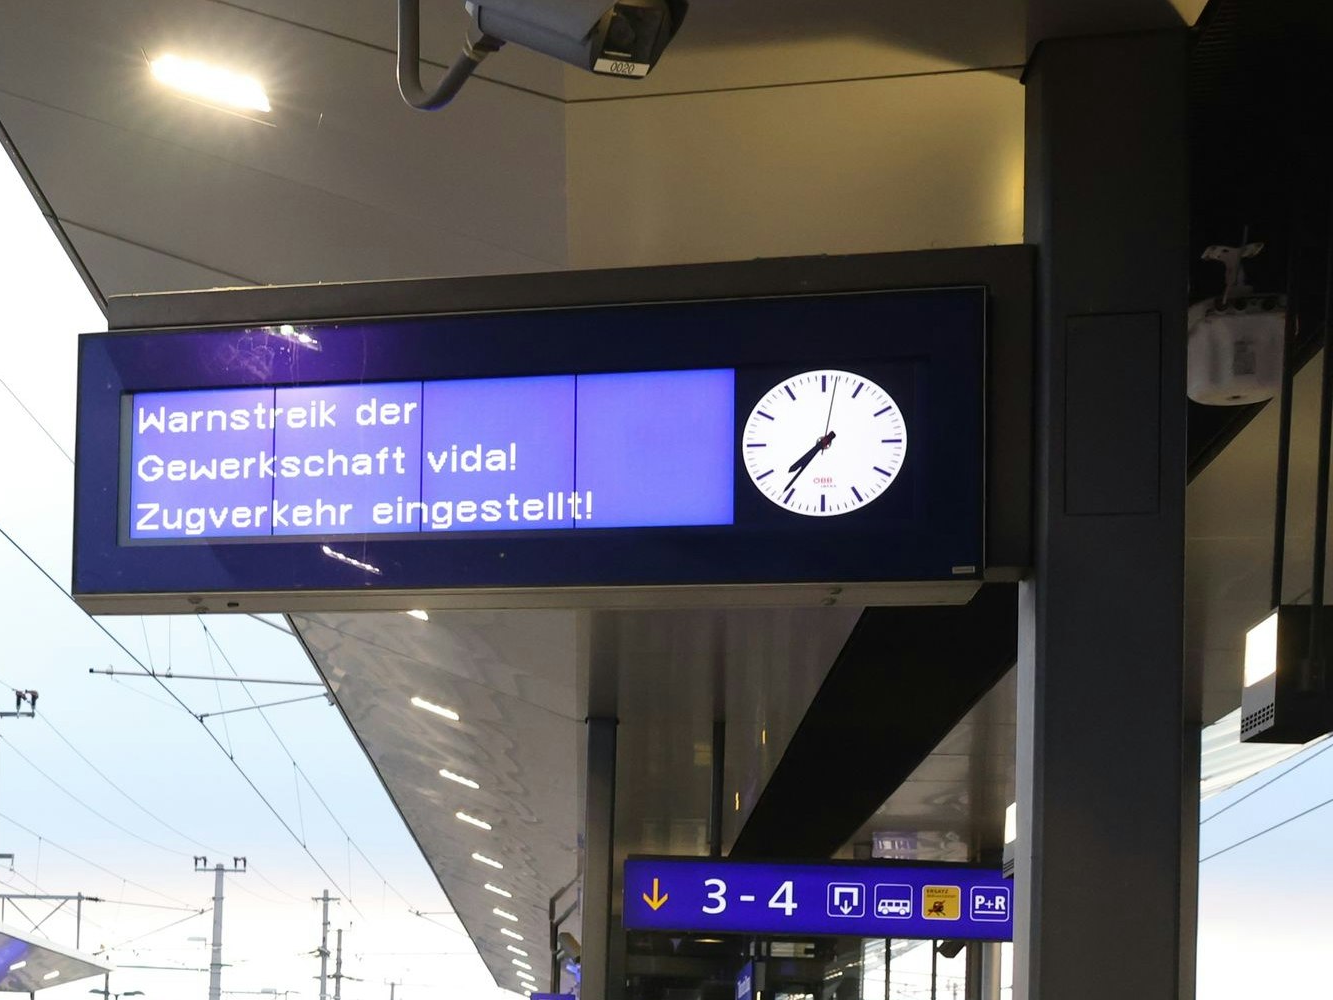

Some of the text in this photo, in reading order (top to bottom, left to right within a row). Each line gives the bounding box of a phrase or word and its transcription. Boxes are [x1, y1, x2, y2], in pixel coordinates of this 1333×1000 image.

[610, 61, 635, 75] 0020
[138, 397, 417, 434] Warnstreik der
[137, 442, 517, 482] Gewerkschaft vida!
[136, 491, 593, 535] Zugverkehr eingestellt!
[974, 895, 1006, 911] P+R
